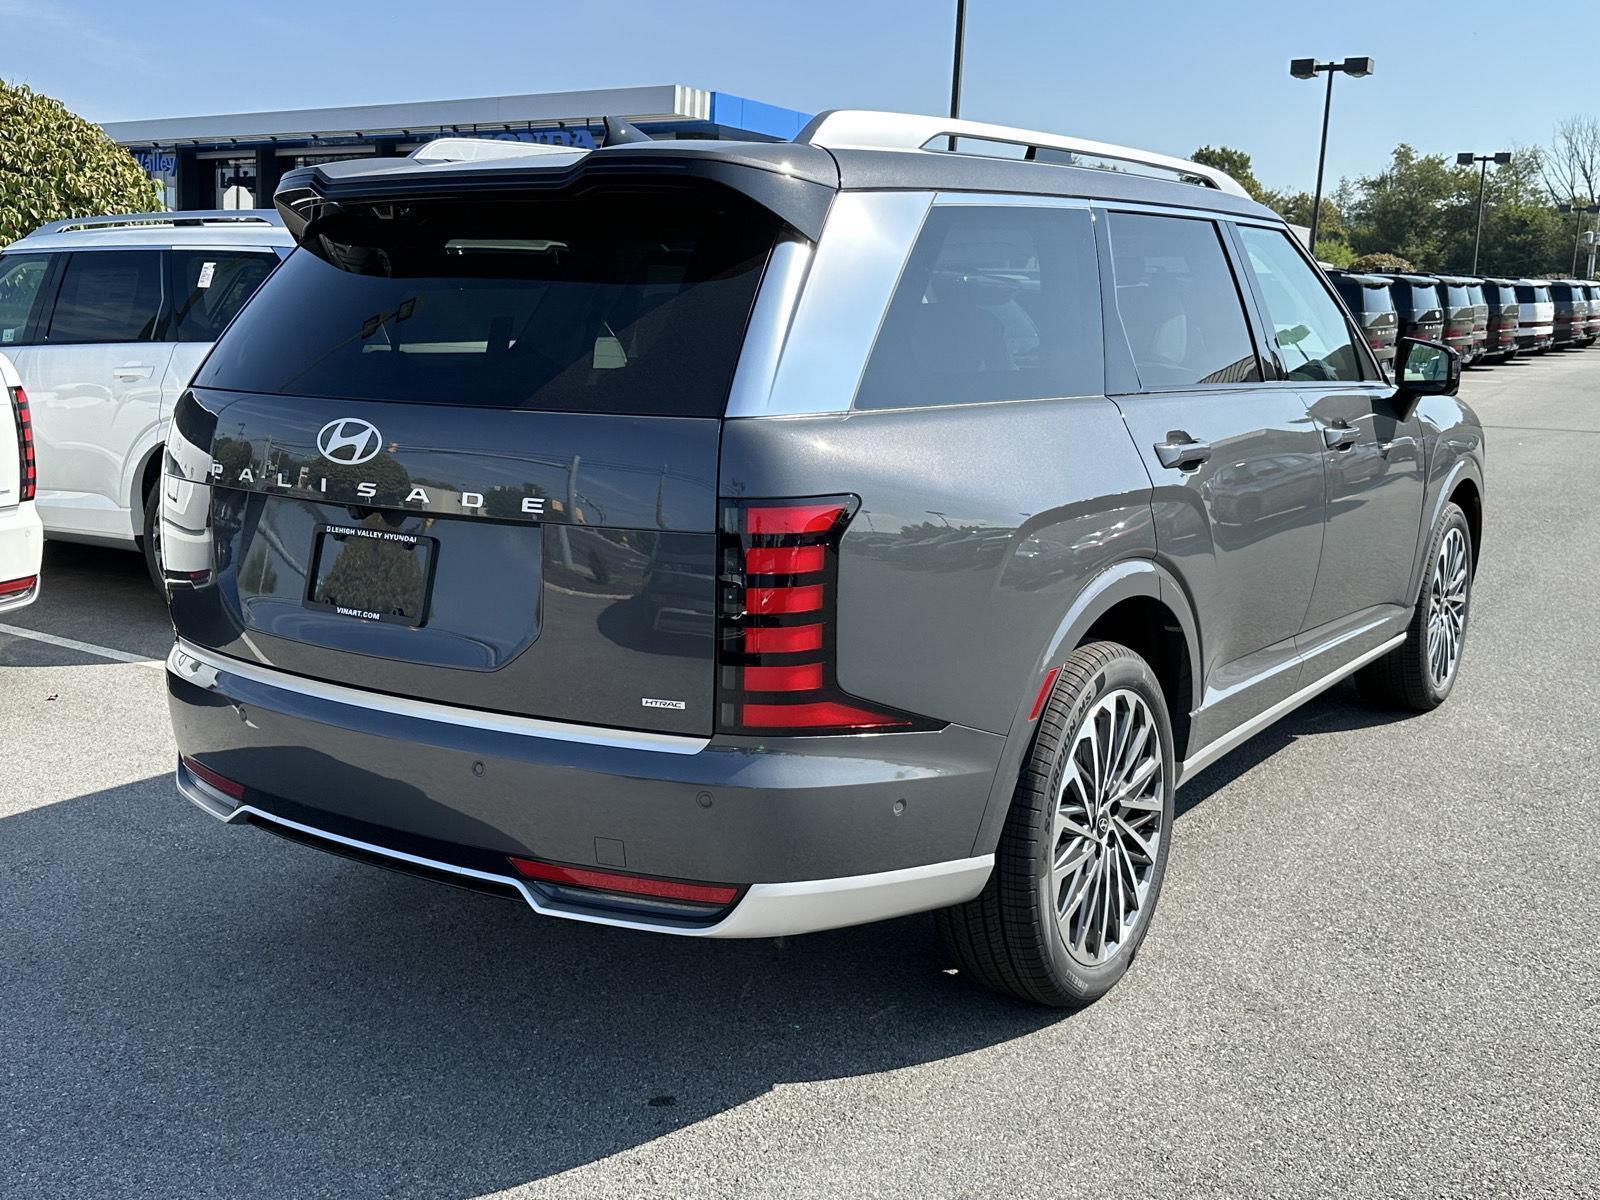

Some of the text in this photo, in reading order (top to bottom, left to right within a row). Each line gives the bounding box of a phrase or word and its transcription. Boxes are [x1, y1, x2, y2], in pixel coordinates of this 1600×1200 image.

[135, 149, 176, 176] Valley
[210, 462, 545, 514] PALISADE
[331, 526, 417, 543] LEHIGH VALLEY HYUNDAI
[336, 606, 380, 620] VINART.COM
[644, 699, 683, 709] HTRAC
[1044, 718, 1077, 835] SCORPION
